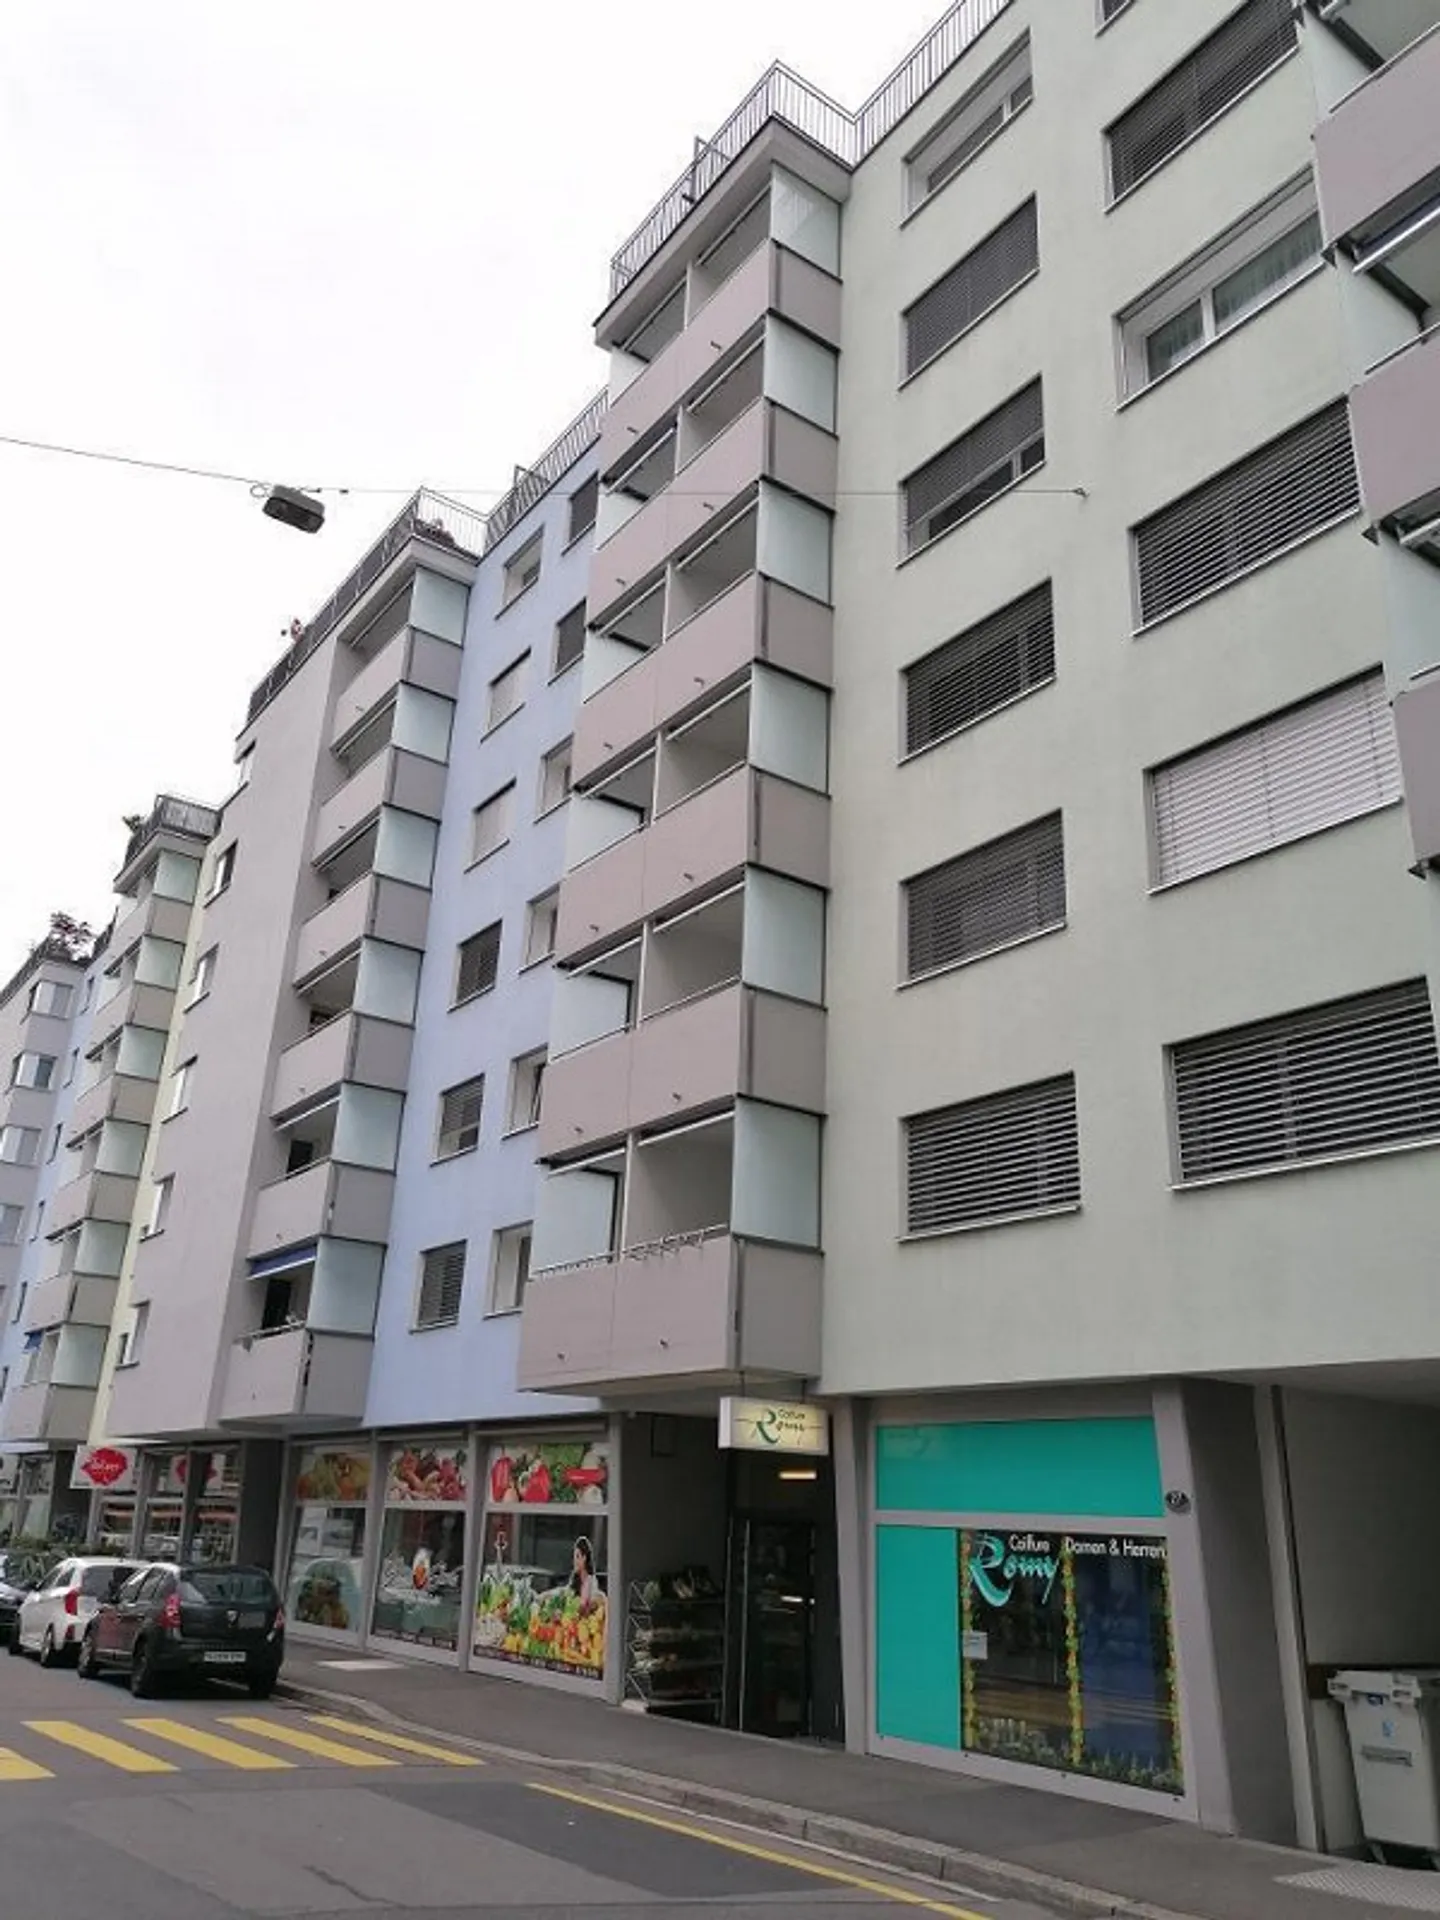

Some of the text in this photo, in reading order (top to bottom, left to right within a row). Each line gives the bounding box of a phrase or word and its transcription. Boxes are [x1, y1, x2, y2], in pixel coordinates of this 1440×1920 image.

[968, 1532, 1061, 1607] Romy
[1065, 1536, 1166, 1558] Damen & Herren
